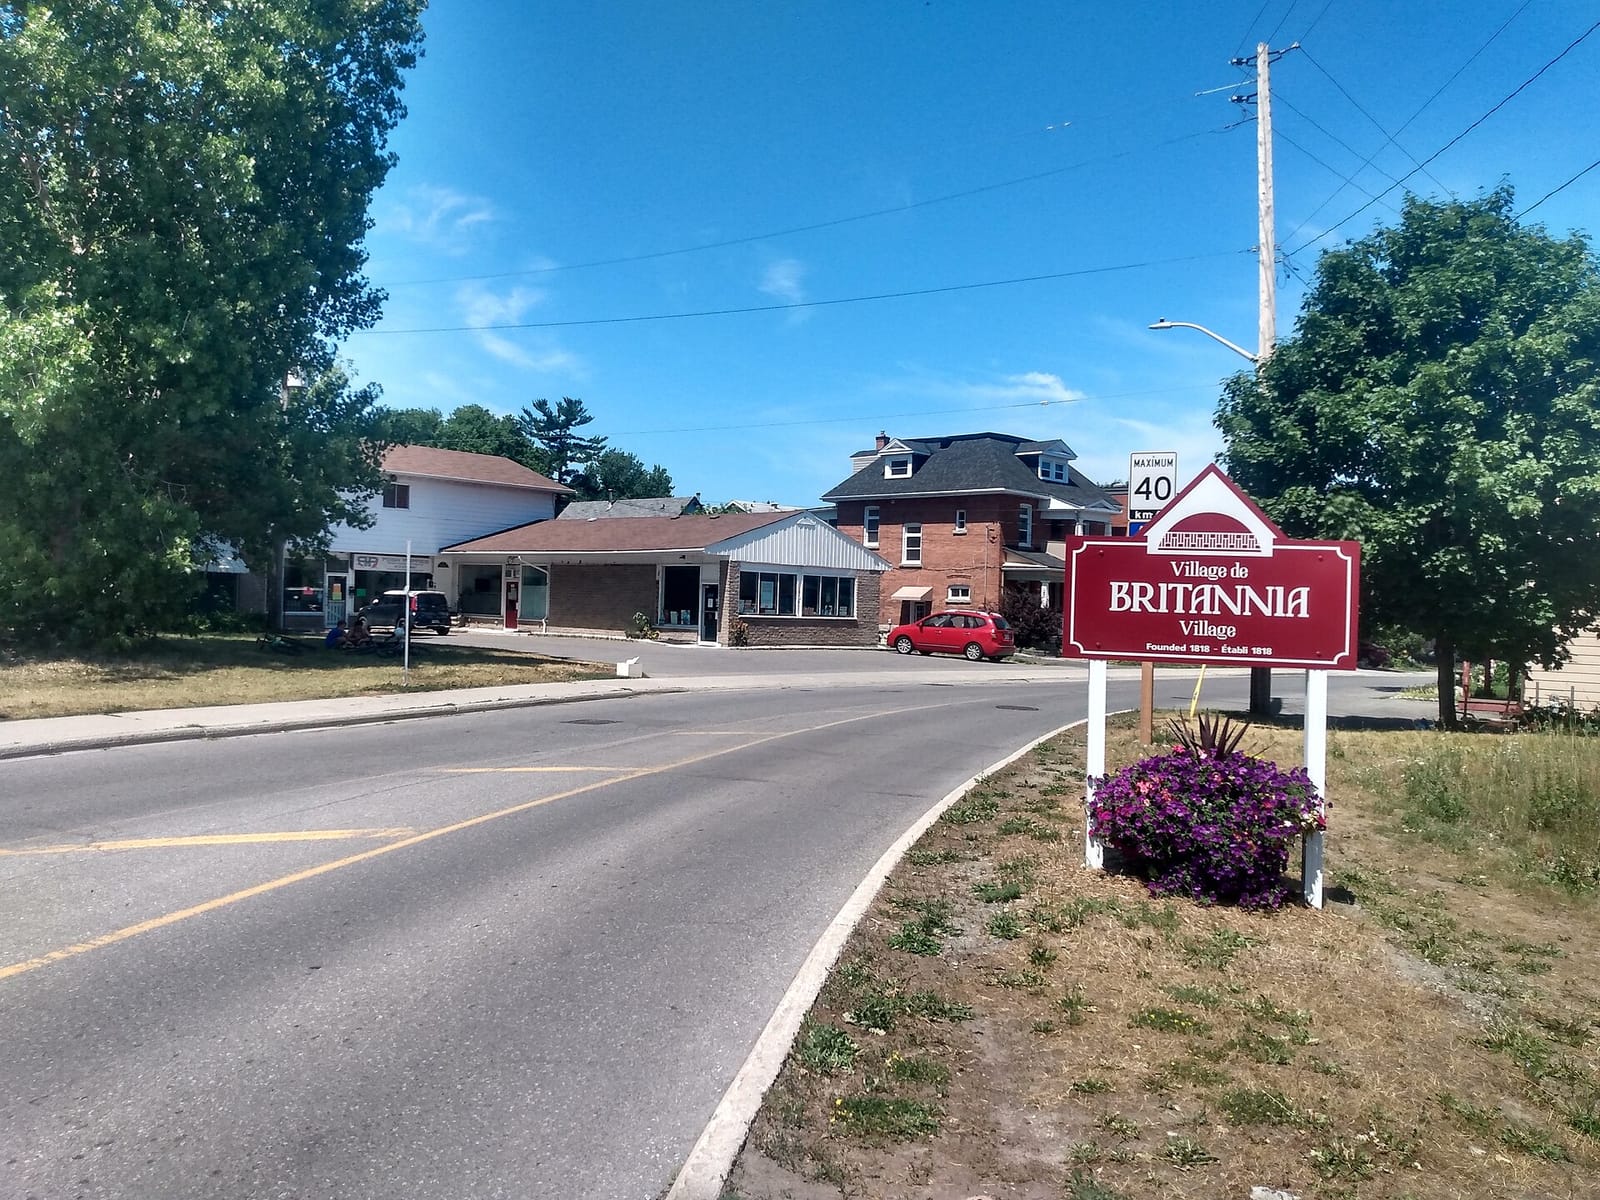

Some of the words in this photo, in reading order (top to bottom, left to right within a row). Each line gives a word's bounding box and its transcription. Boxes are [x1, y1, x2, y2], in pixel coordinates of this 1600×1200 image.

[1133, 458, 1174, 468] MAXIMUM
[1134, 476, 1171, 501] 40
[1170, 560, 1227, 580] Village
[1230, 561, 1249, 579] de
[1108, 581, 1311, 618] BRITANNIA
[1179, 620, 1237, 640] Village
[1146, 642, 1187, 653] Founded
[1189, 644, 1211, 653] 1818
[1221, 643, 1249, 655] Établi
[1251, 646, 1273, 656] 1818
